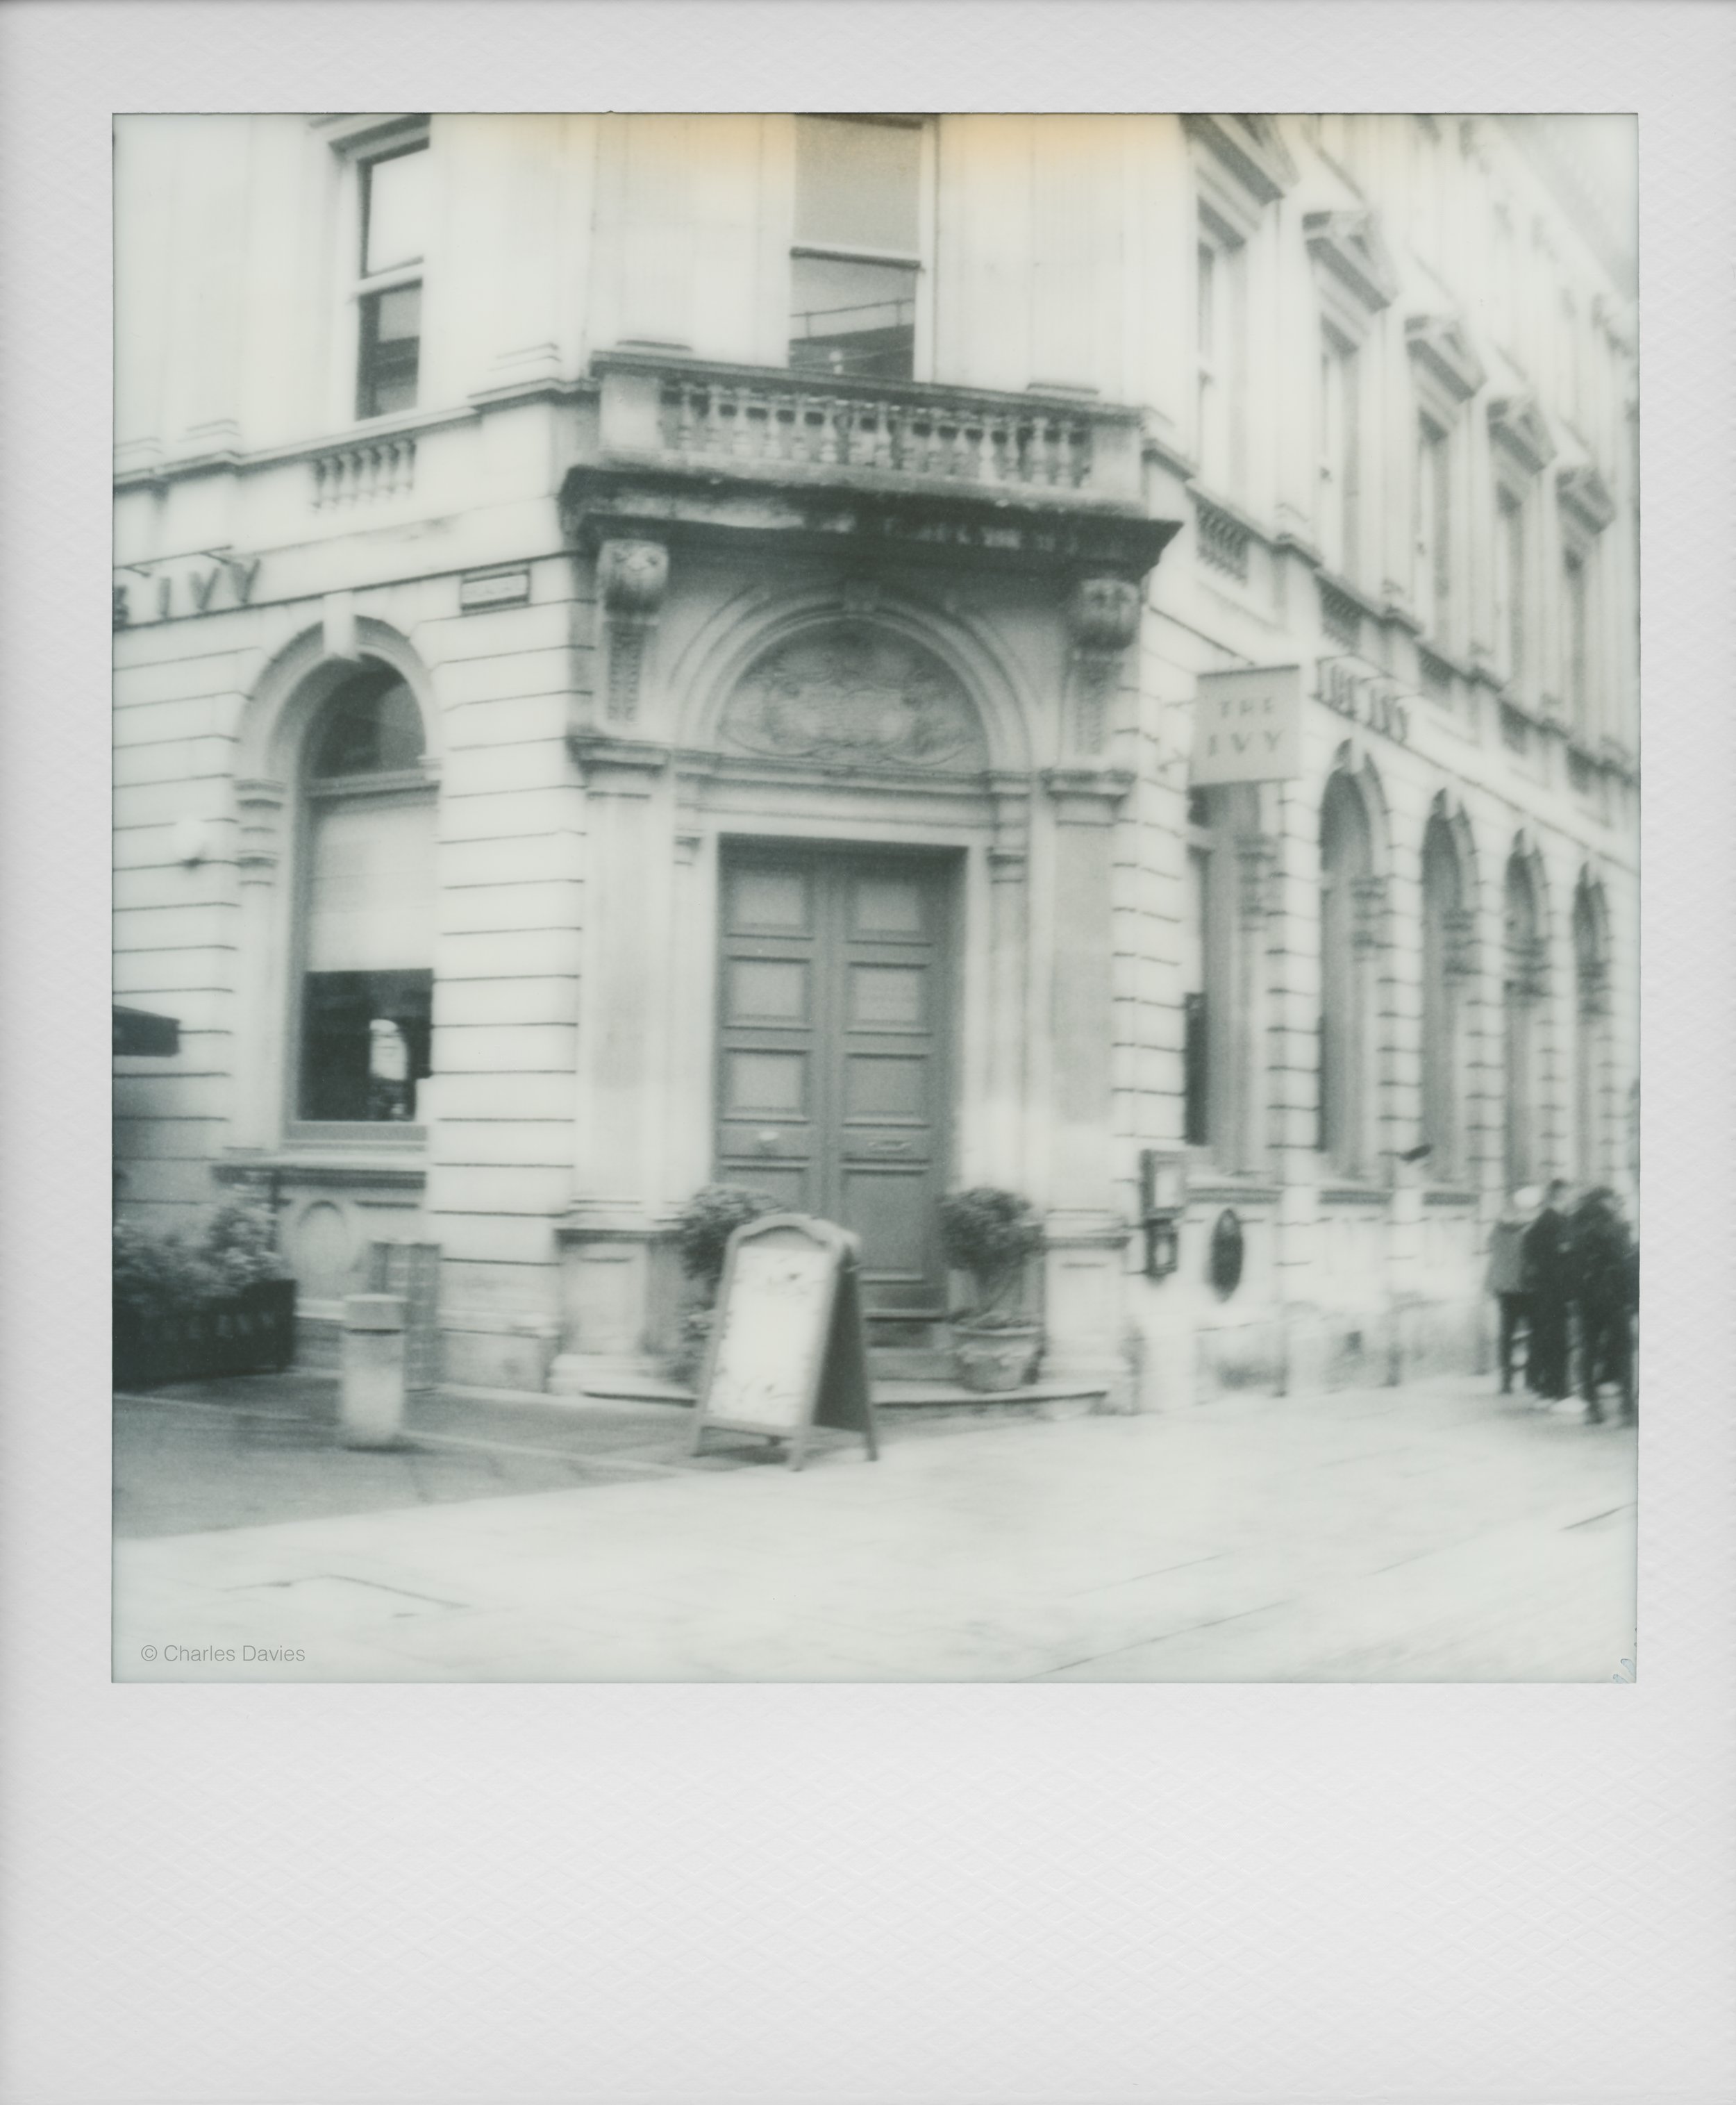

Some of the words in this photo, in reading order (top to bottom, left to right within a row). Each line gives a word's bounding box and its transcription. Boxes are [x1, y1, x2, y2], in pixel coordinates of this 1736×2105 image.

[158, 558, 261, 619] IVY
[1217, 696, 1276, 719] THE
[1206, 728, 1286, 758] IVY
